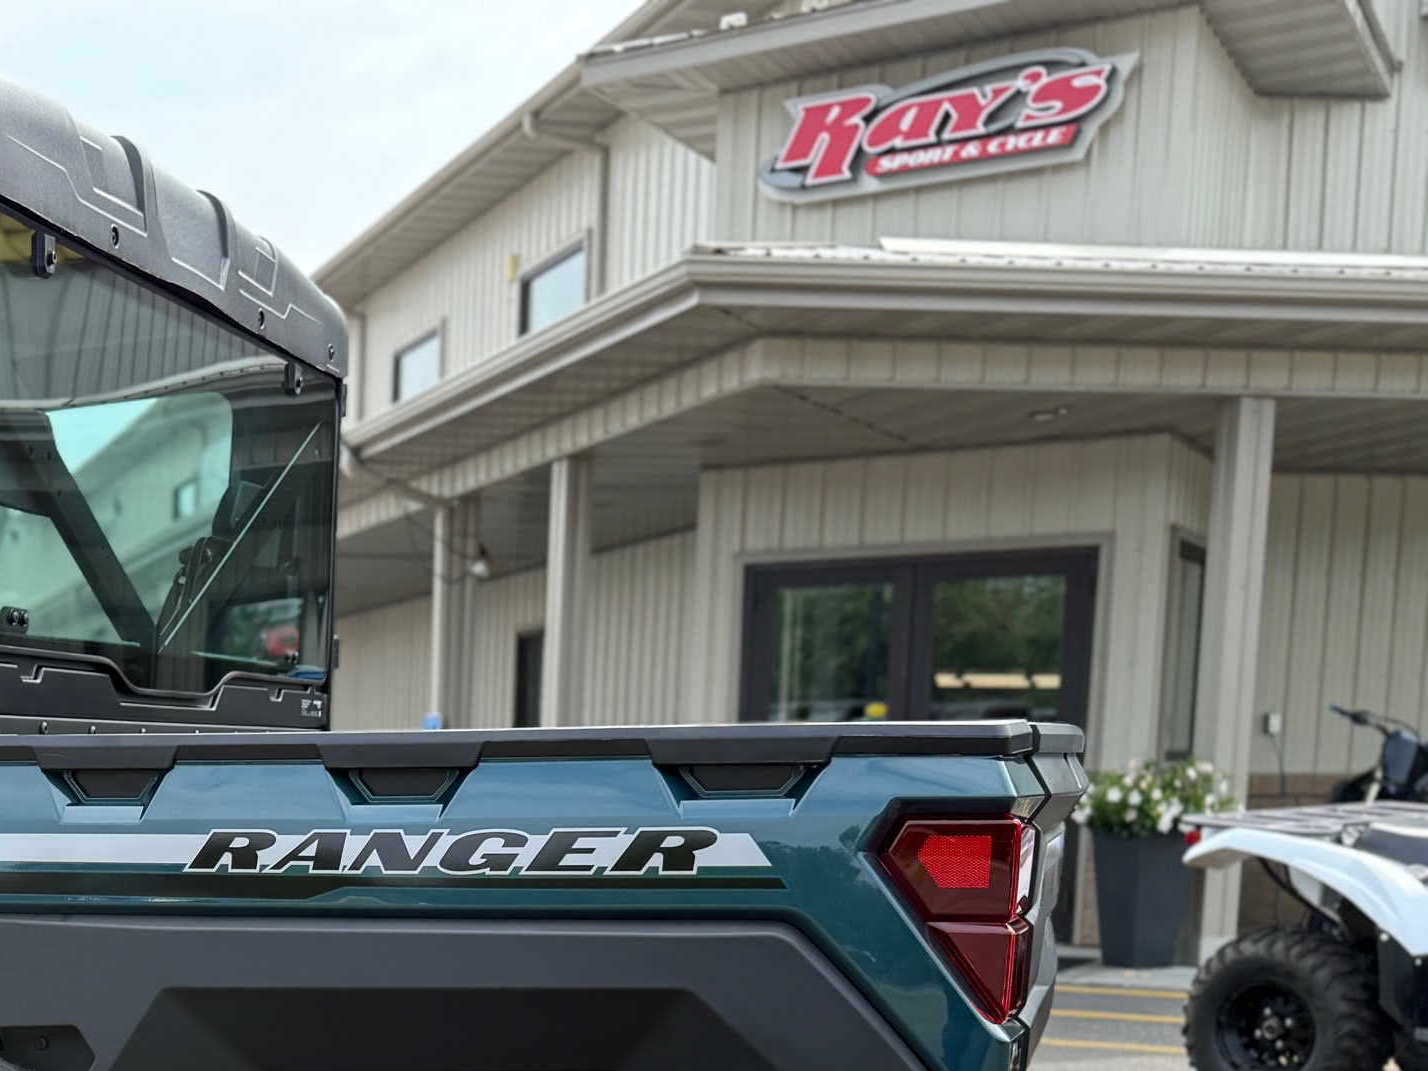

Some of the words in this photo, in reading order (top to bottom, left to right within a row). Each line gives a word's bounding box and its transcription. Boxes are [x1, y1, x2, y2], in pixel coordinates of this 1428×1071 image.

[876, 143, 960, 172] SPORT
[959, 141, 978, 158] &
[986, 127, 1068, 154] CYCLE
[183, 827, 719, 876] RANGER
